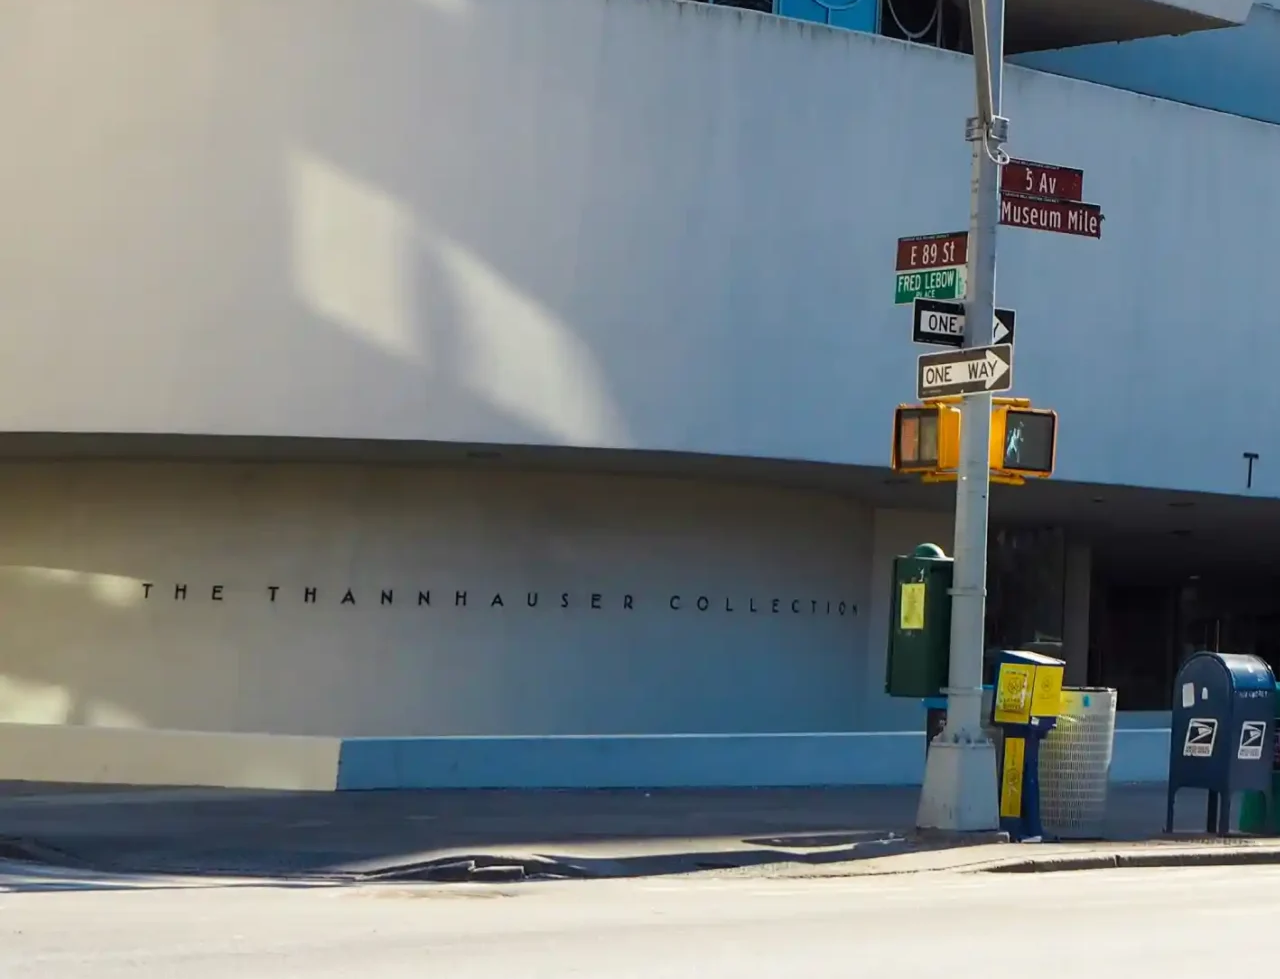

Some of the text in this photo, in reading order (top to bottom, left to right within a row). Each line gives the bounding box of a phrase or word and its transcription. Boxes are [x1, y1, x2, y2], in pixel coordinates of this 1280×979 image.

[1026, 168, 1057, 194] 5 Av
[1001, 201, 1098, 233] Museum Mile
[910, 241, 955, 265] E 89 St
[898, 274, 922, 293] FRED
[925, 269, 955, 289] LEBOW
[928, 314, 958, 333] ONE
[926, 360, 998, 384] ONE WAY
[142, 583, 858, 616] THE THANNHAUSER COLLECTION
